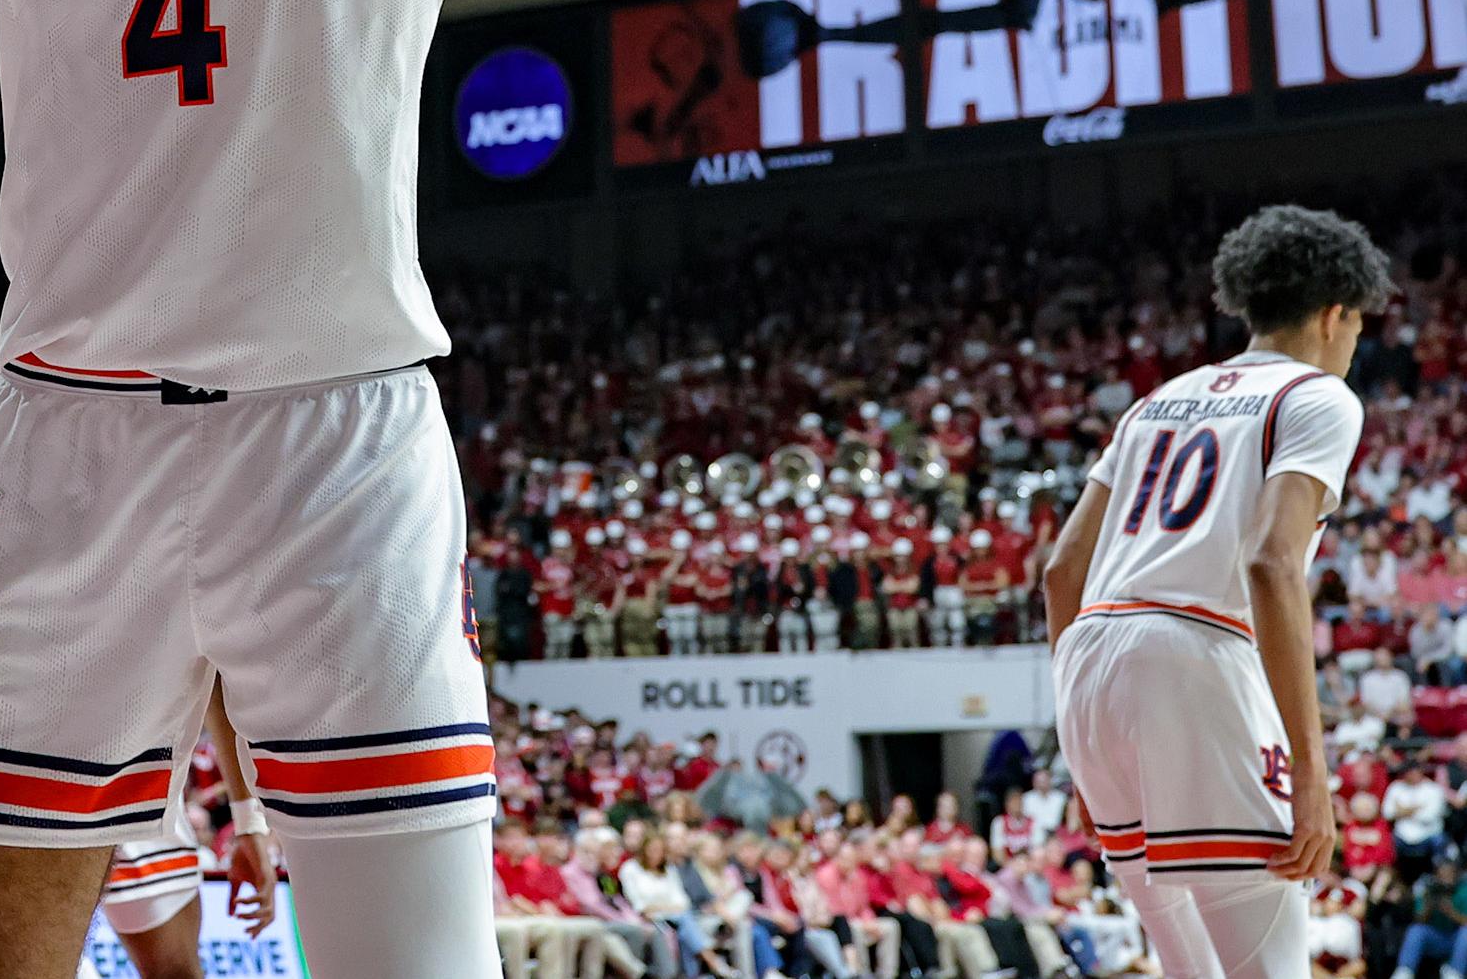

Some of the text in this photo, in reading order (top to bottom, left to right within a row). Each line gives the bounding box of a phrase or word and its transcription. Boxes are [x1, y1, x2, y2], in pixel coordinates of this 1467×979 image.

[466, 103, 563, 149] NCAA
[1123, 428, 1221, 536] 10
[641, 675, 814, 711] ROLL TIDE
[200, 940, 286, 976] ERVE
